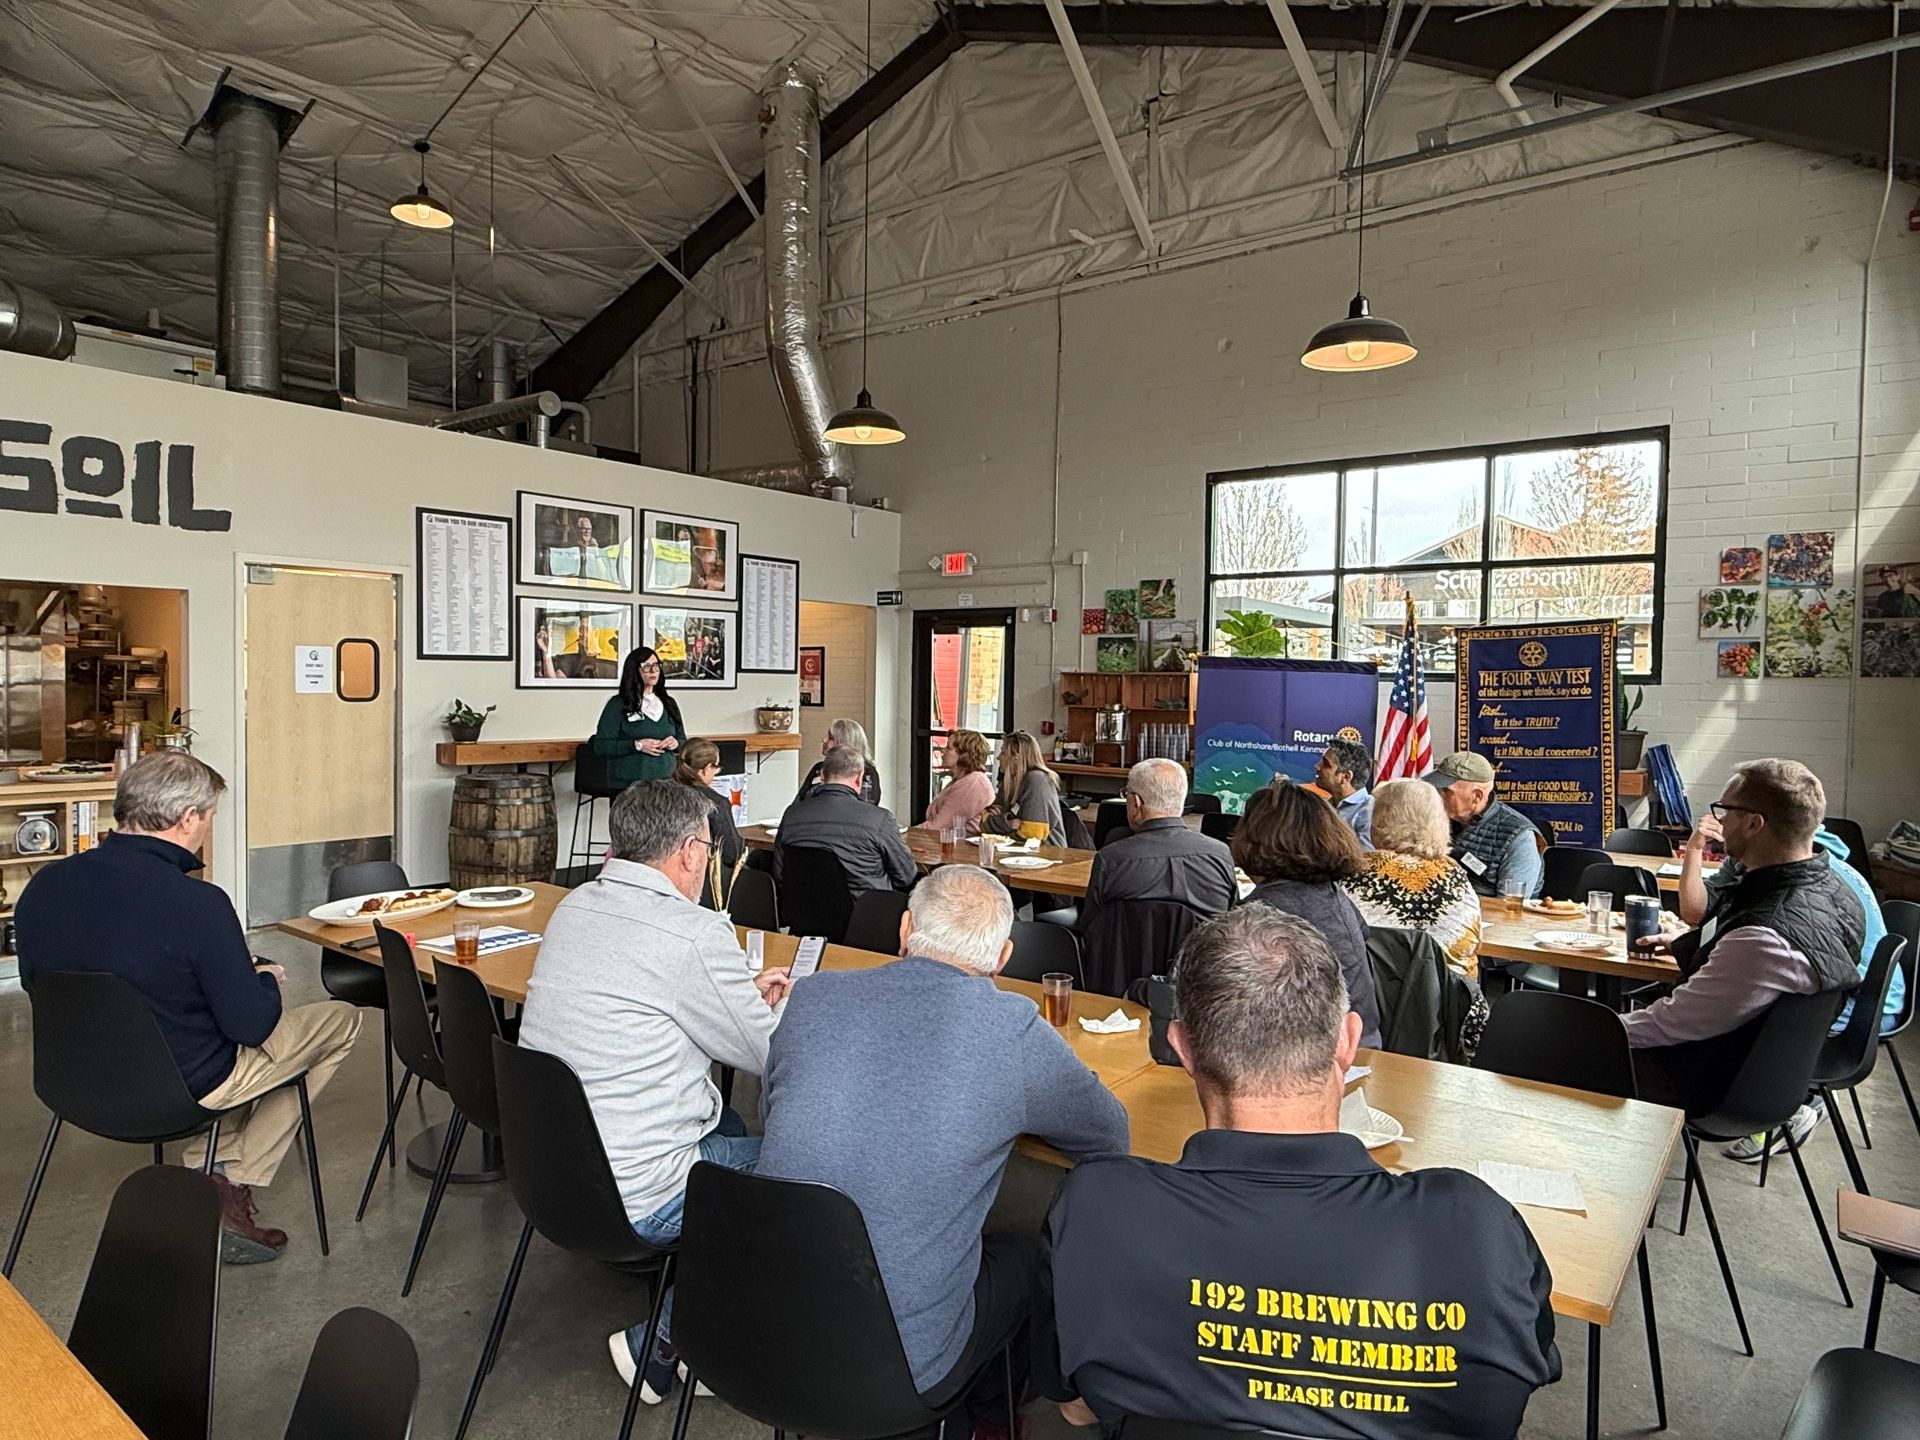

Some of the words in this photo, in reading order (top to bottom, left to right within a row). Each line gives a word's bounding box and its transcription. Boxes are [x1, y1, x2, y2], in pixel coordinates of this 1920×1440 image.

[1480, 671, 1499, 686] THE
[1502, 670, 1564, 685] FOUR-WAY
[1566, 669, 1591, 684] TEST
[1478, 688, 1487, 697] of
[1487, 687, 1499, 696] the
[1580, 685, 1591, 695] do
[1494, 718, 1501, 727] Is
[1502, 718, 1508, 727] it
[1510, 718, 1522, 727] the
[1293, 730, 1334, 745] Rotary
[1207, 739, 1223, 748] Club
[1225, 739, 1233, 748] of
[1300, 745, 1330, 755] Kenmor
[1494, 747, 1501, 756] Is
[1502, 747, 1508, 756] it
[1508, 747, 1523, 756] FAIR
[1524, 747, 1532, 756] to
[1533, 747, 1545, 756] all
[1517, 781, 1537, 791] build
[1537, 781, 1560, 791] GOOD
[1561, 781, 1580, 791] WILL
[1511, 792, 1538, 801] BETTER
[1575, 822, 1584, 832] to
[1190, 1279, 1246, 1313] 192
[1257, 1288, 1418, 1331] BREWING
[1426, 1302, 1467, 1331] CO
[1197, 1321, 1303, 1359] STAFF
[1311, 1335, 1458, 1372] MEMBER
[1248, 1379, 1335, 1408] PLEASE
[1340, 1390, 1410, 1413] CHILL
